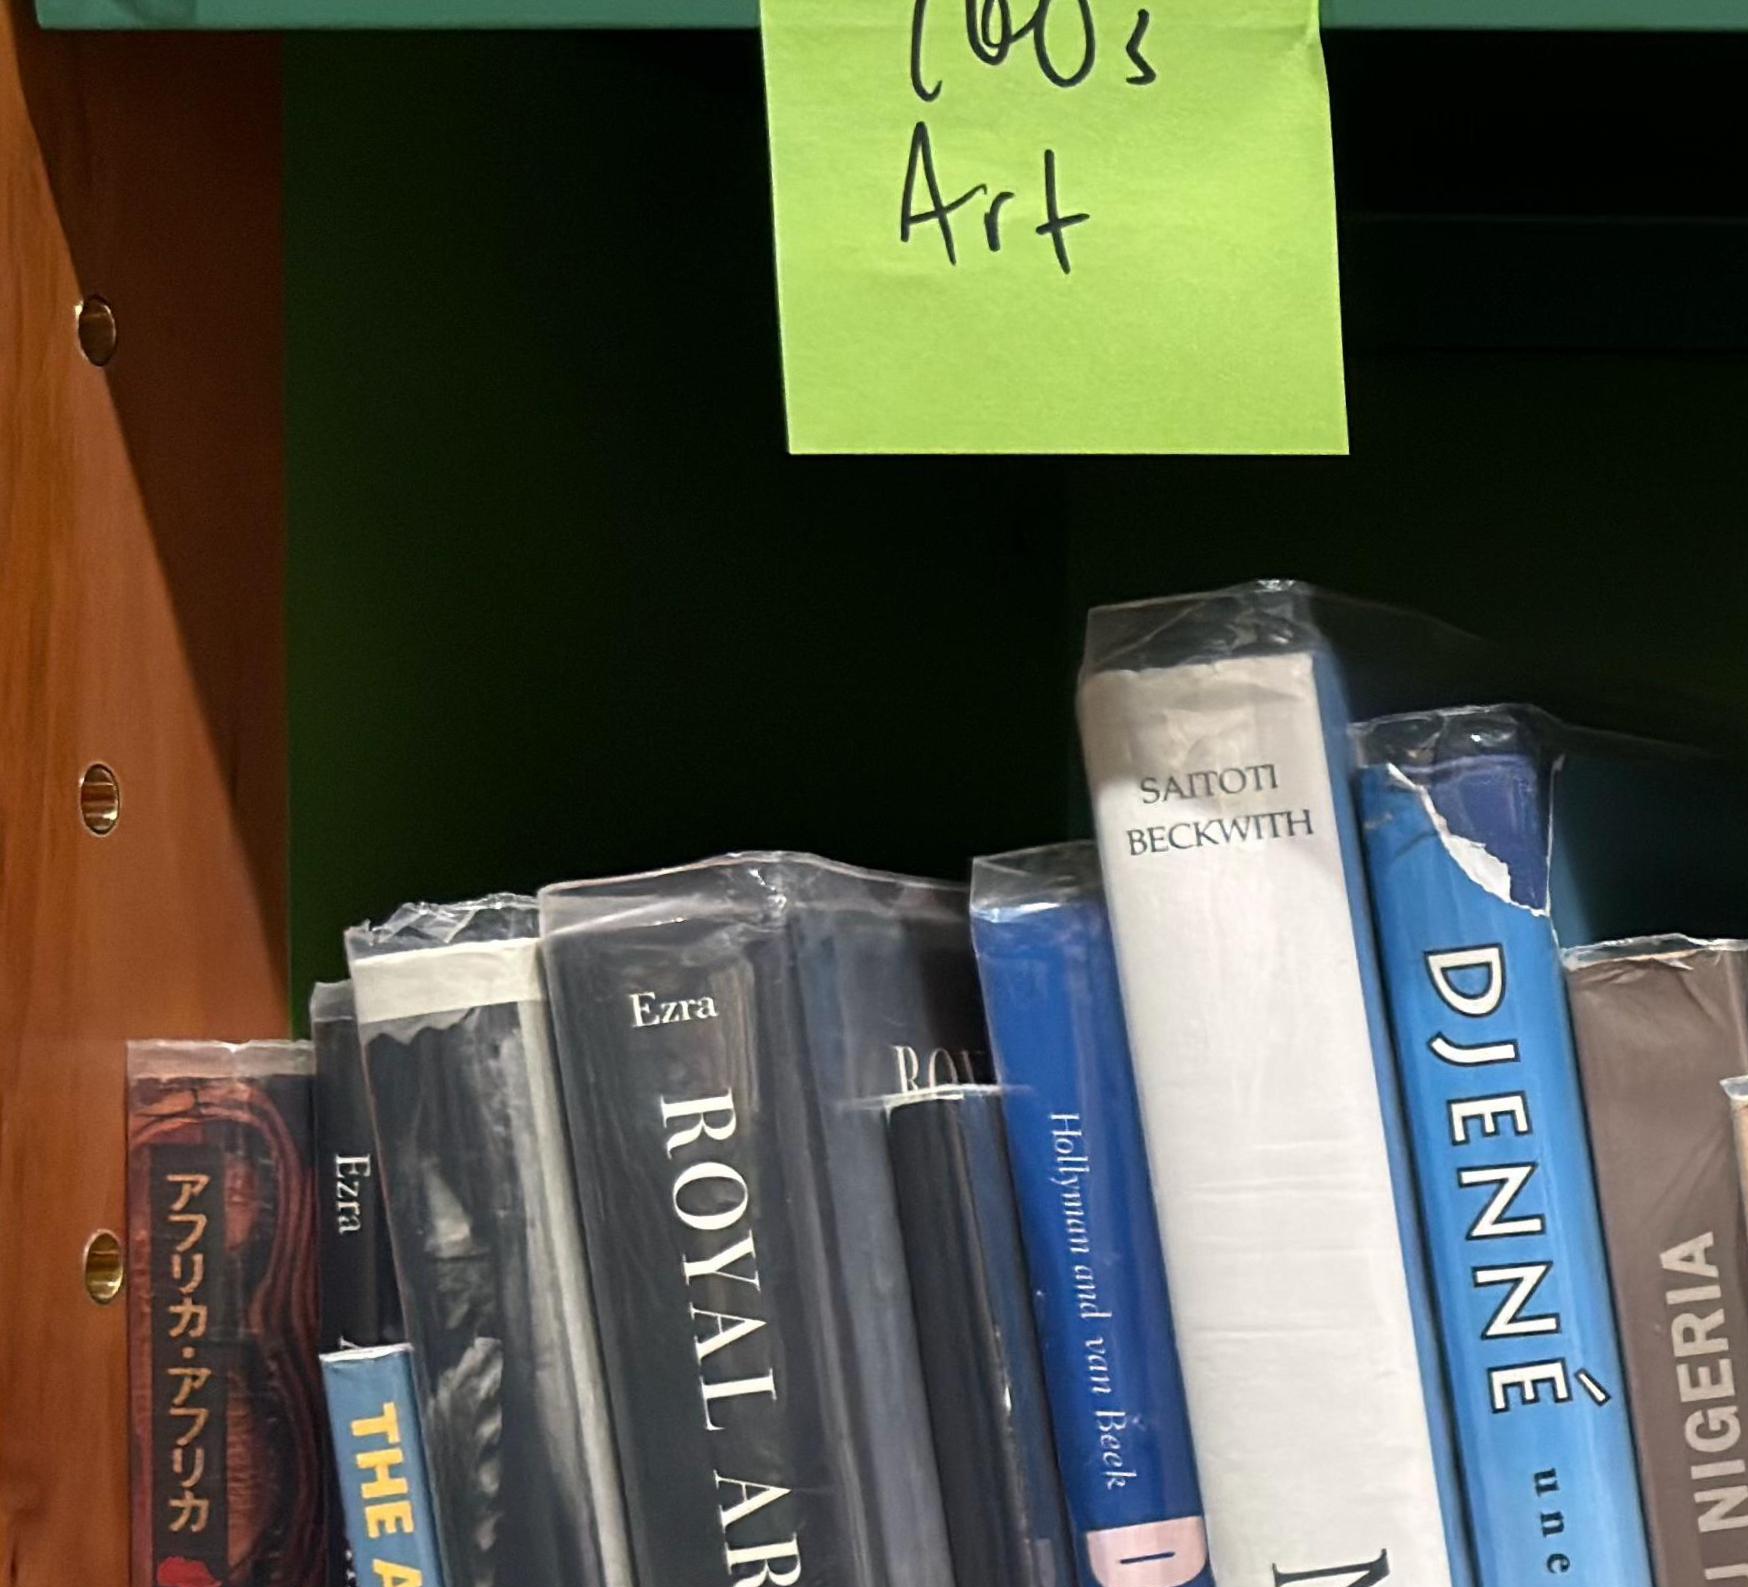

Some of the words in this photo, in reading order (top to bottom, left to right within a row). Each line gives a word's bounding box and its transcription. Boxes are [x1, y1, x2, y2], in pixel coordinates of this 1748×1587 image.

[900, 121, 1091, 274] Art
[1139, 763, 1280, 805] SAITOTI
[1127, 808, 1314, 857] BECKWITH
[628, 990, 718, 1031] Ezra
[334, 1152, 372, 1235] Ezra
[1048, 1111, 1091, 1255] Hollyman
[1423, 943, 1612, 1415] DJENNÉ
[658, 1087, 779, 1433] ROYAL
[1072, 1263, 1111, 1320] and
[1084, 1337, 1112, 1395] van
[349, 1402, 415, 1535] THE
[1094, 1409, 1138, 1491] Beek
[1532, 1466, 1572, 1577] une
